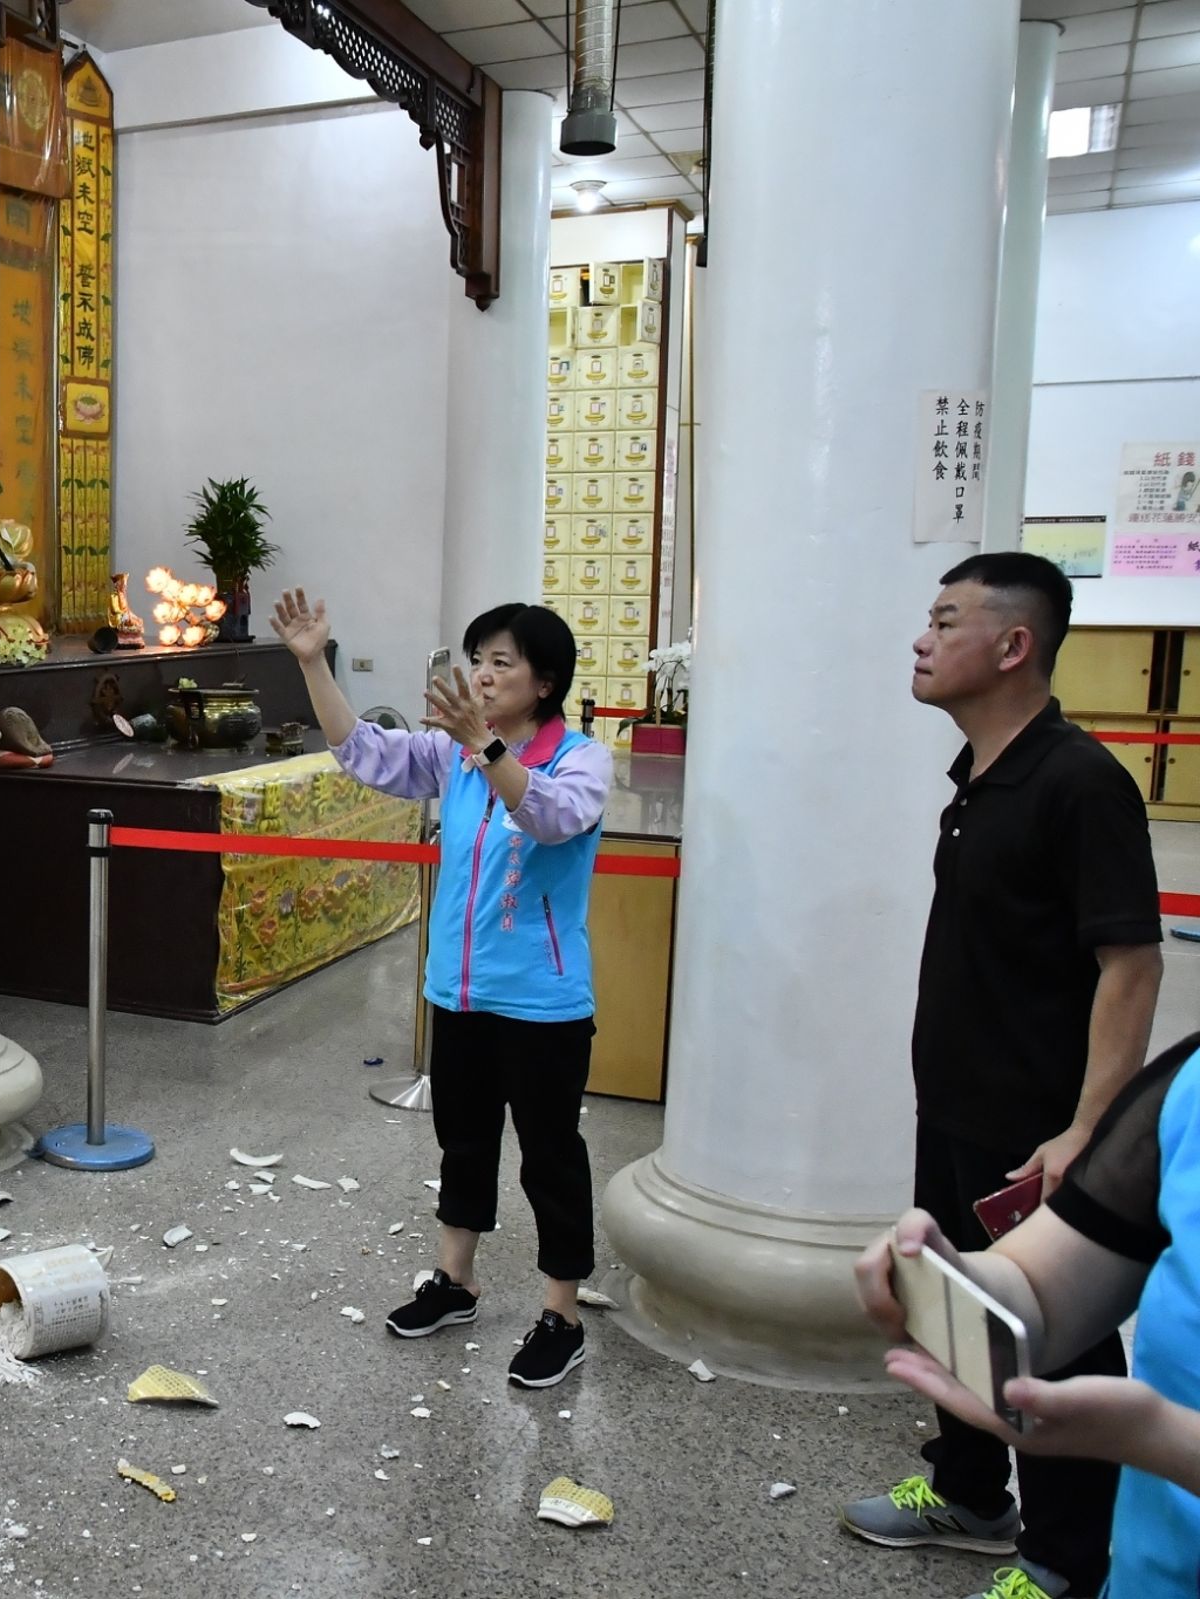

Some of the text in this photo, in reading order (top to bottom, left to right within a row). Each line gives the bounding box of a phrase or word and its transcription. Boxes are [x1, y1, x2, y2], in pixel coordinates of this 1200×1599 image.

[74, 131, 97, 372] 地獄未空 誓不成佛
[932, 395, 949, 481] 禁止飲食
[952, 397, 970, 524] 全程佩戴口罩
[972, 400, 985, 481] 防疫期間
[1153, 451, 1196, 467] 紙錢
